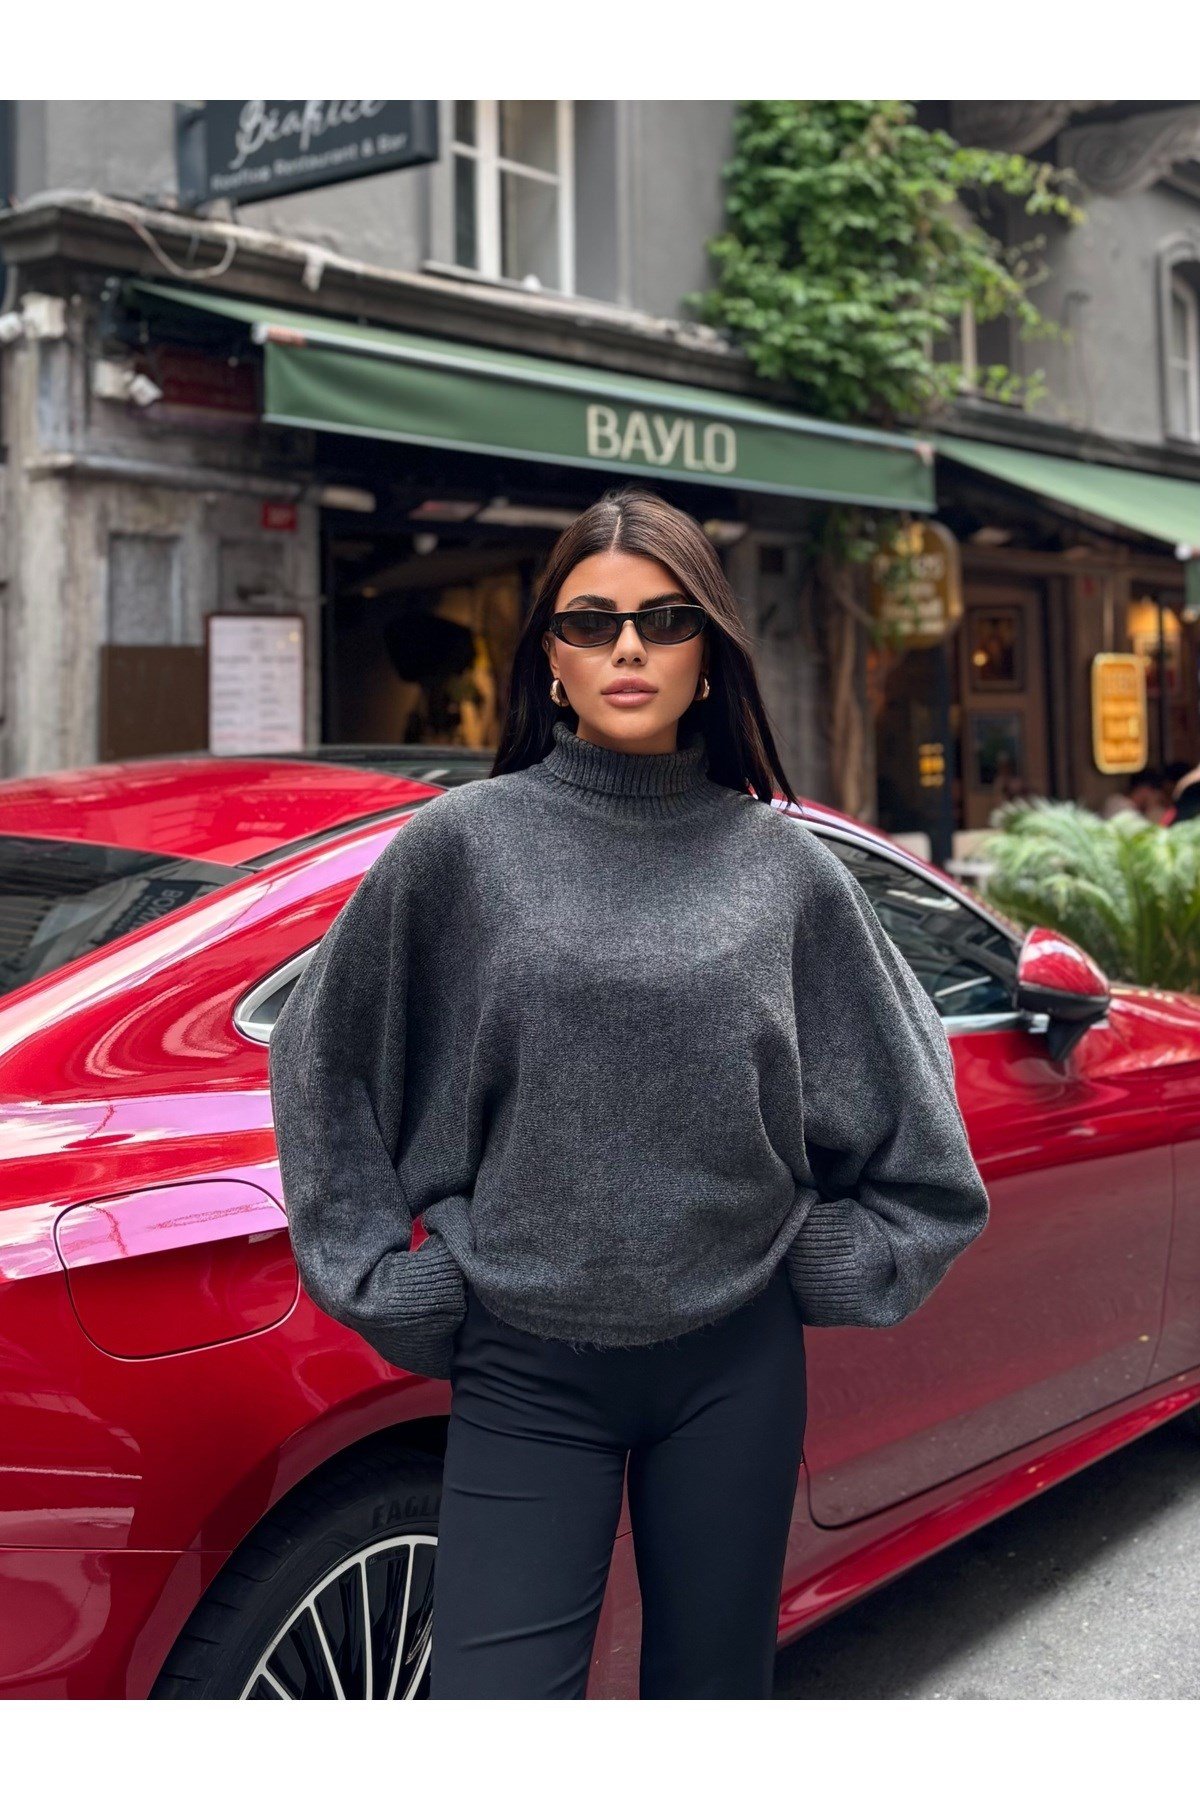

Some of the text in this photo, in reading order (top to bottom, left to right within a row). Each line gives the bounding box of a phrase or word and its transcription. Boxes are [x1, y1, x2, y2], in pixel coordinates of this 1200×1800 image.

[273, 143, 358, 175] Restaurant
[376, 133, 407, 155] Bar
[586, 403, 737, 473] BAYLO
